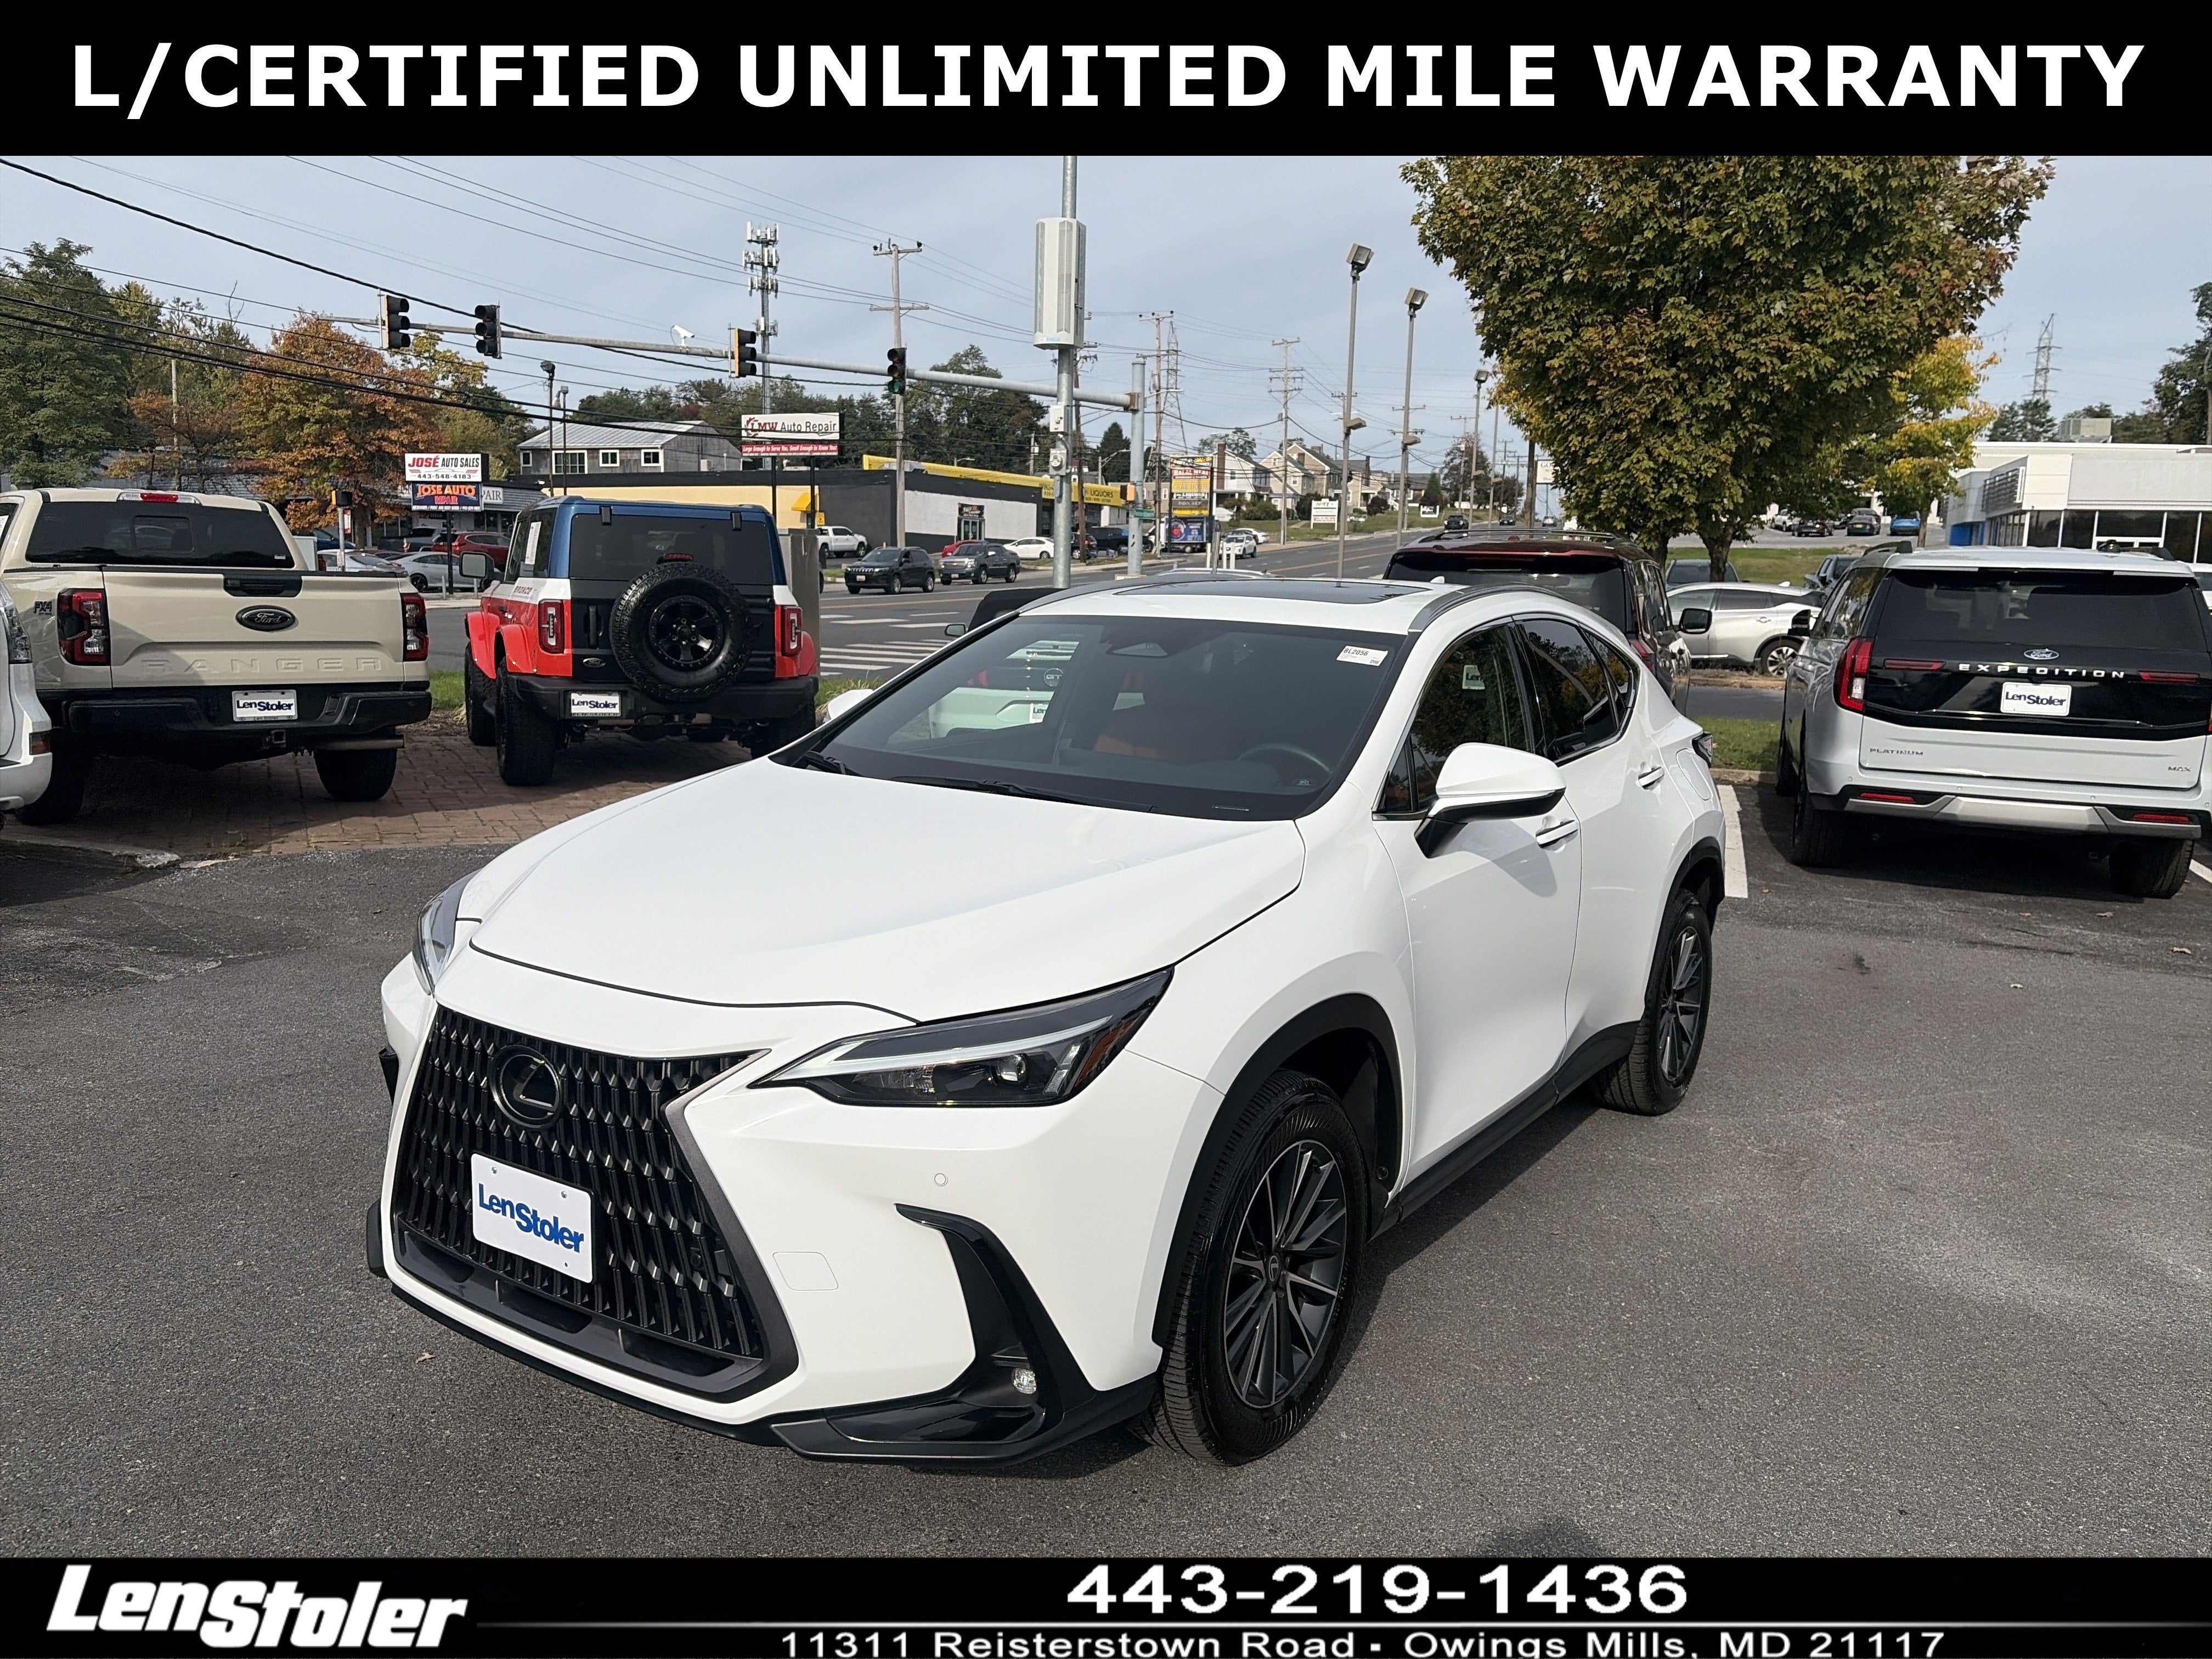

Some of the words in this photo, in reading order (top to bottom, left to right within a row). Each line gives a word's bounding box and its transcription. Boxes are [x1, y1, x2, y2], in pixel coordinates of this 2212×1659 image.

[781, 422, 802, 432] Auto
[805, 421, 837, 433] Repair
[408, 455, 439, 467] JOSÉ
[441, 458, 458, 467] AUTO
[460, 458, 479, 467] SALES
[416, 484, 442, 496] JOSE
[444, 484, 476, 496] AUTO
[1090, 490, 1113, 498] LIQUORS
[254, 612, 281, 624] Ford
[2029, 650, 2052, 658] Ford
[142, 657, 381, 674] RANGER
[1959, 663, 2124, 679] EXPEDITION
